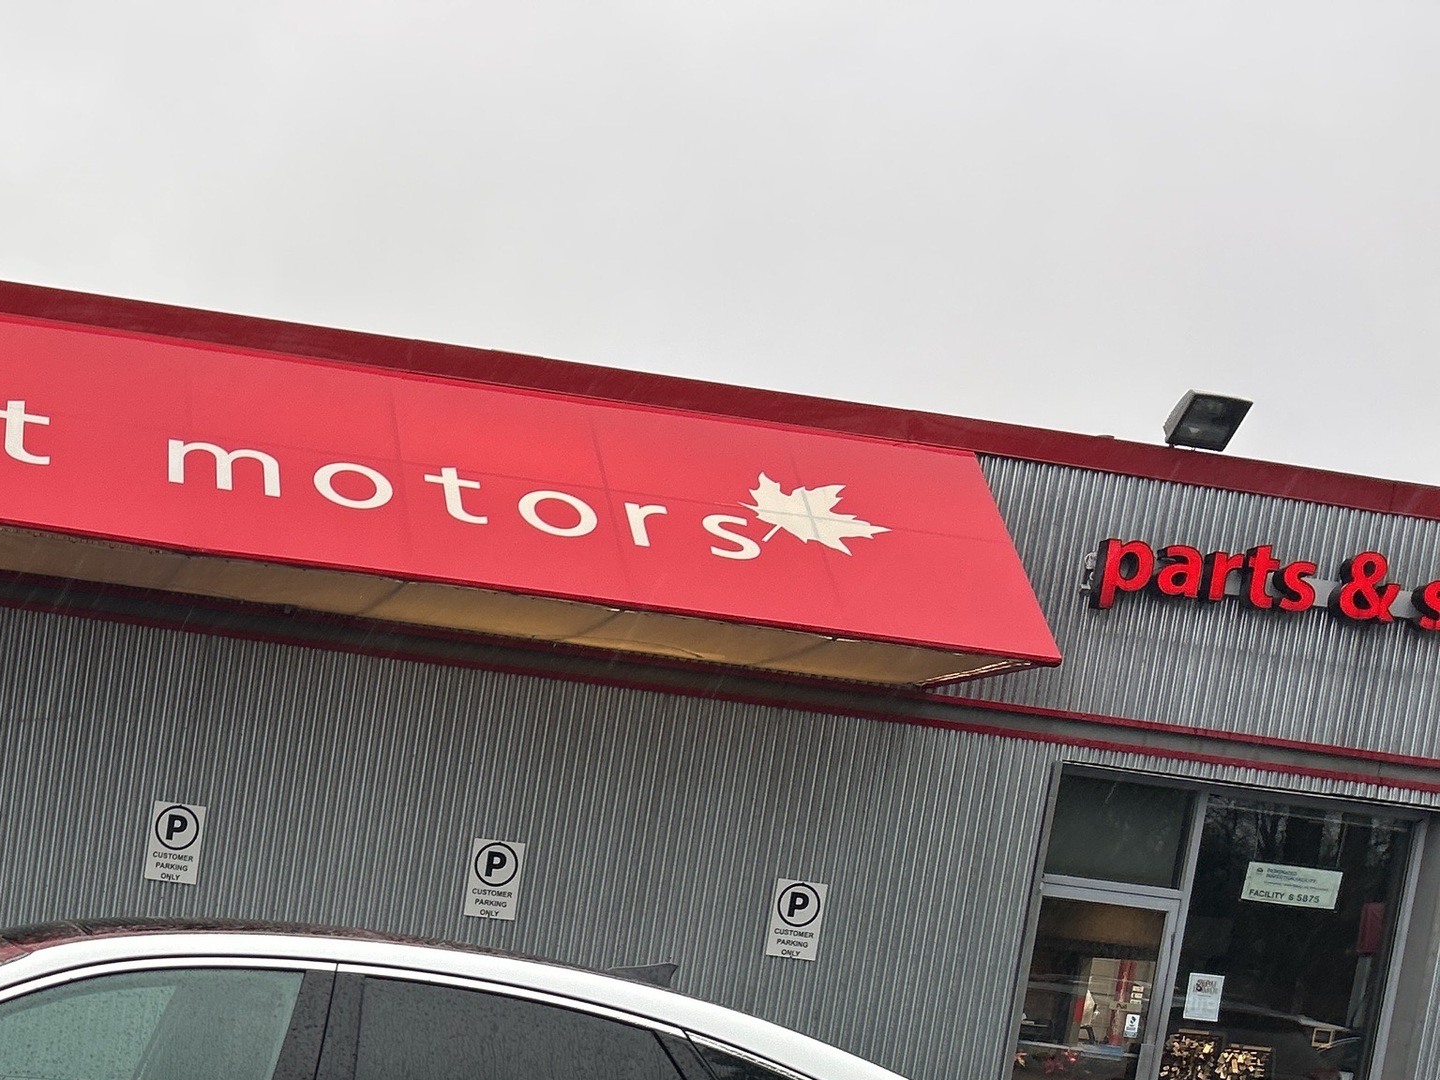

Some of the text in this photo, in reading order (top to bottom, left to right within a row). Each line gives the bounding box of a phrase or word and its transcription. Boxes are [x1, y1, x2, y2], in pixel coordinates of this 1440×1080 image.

[166, 437, 761, 561] motors
[1094, 537, 1318, 613] parts
[1335, 550, 1400, 623] &
[165, 814, 188, 840] P
[152, 851, 194, 862] CUSTOMER
[155, 861, 188, 872] PARKING
[485, 851, 507, 877] P
[160, 872, 181, 881] ONLY
[472, 888, 513, 898] CUSTOMER
[1248, 889, 1285, 899] FACILITY
[474, 898, 507, 908] PARKING
[787, 892, 810, 917] P
[480, 909, 500, 917] ONLY
[774, 928, 814, 939] CUSTOMER
[776, 938, 809, 948] PARKING
[781, 949, 801, 957] ONLY
